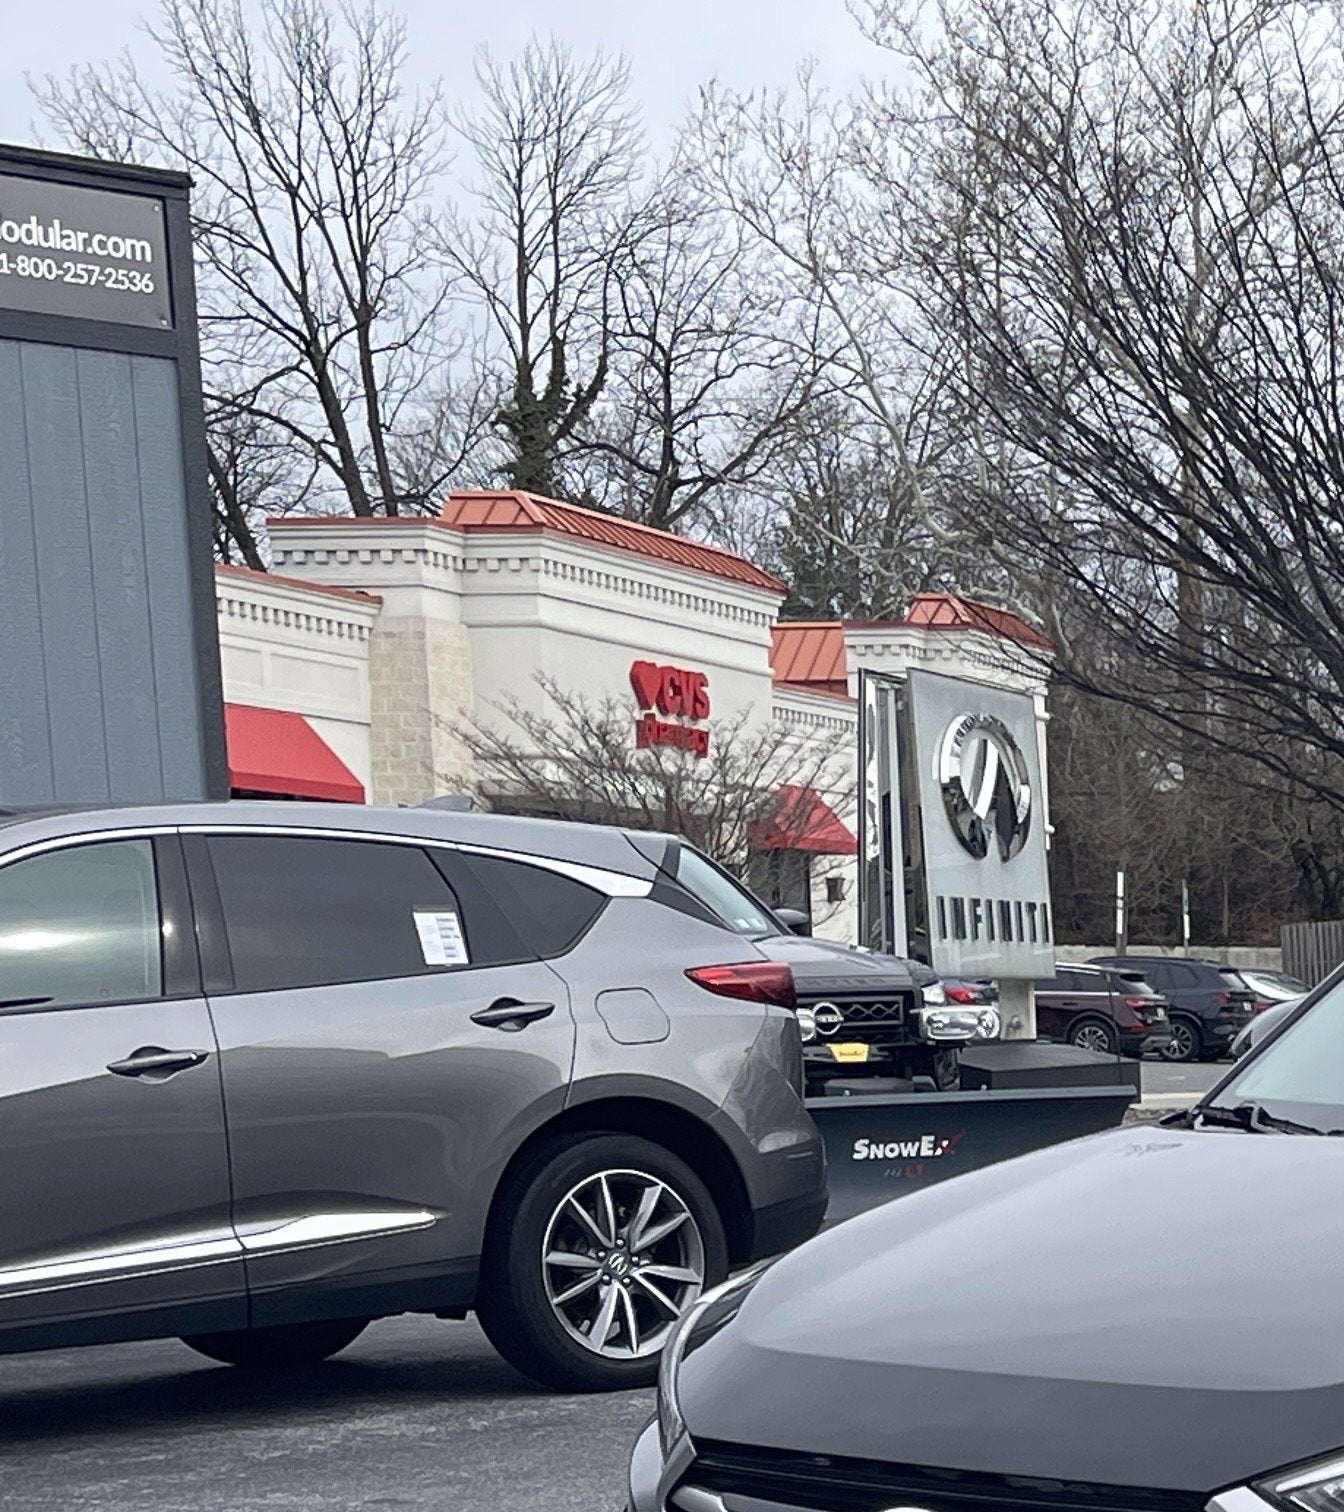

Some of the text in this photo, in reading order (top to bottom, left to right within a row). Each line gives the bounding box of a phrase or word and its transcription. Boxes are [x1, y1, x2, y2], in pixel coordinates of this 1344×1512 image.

[0, 252, 154, 293] 1-800-257-2536
[657, 666, 710, 720] CVS
[936, 896, 1049, 943] INFINITI
